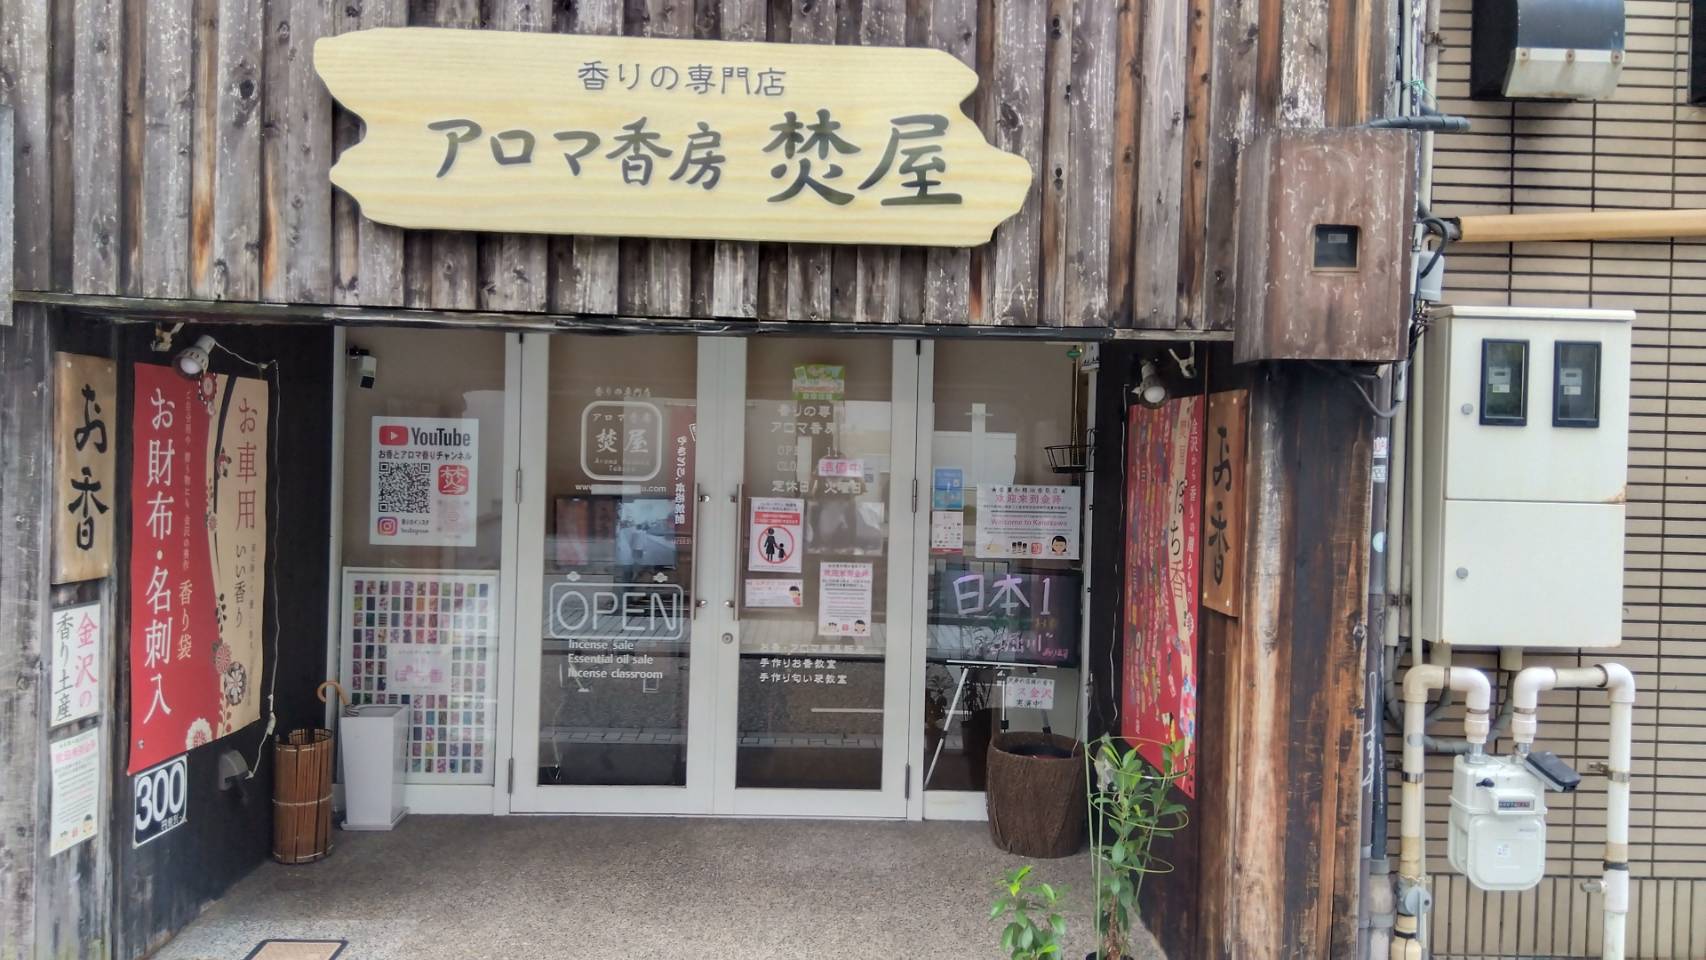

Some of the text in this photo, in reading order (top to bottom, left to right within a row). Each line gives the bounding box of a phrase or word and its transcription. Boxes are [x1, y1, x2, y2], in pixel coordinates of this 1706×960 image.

[577, 60, 787, 97] 香りの専門店
[427, 108, 964, 206] アロマ香房 焚屋
[68, 383, 109, 551] お香
[236, 398, 258, 530] お車用
[411, 427, 471, 447] YouTube
[595, 428, 649, 454] 焚屋
[1207, 427, 1233, 586] お香
[143, 387, 175, 724] お財布・名刺入
[177, 579, 193, 660] 香り袋
[557, 591, 678, 630] OPEN
[569, 639, 635, 650] Incense sale
[55, 611, 74, 720] 香り土産
[75, 612, 98, 708] 金沢の
[568, 653, 654, 664] Essential oil sale
[568, 667, 663, 679] Incense classroom
[759, 658, 837, 670] 手作りお香教室
[136, 762, 186, 831] 300
